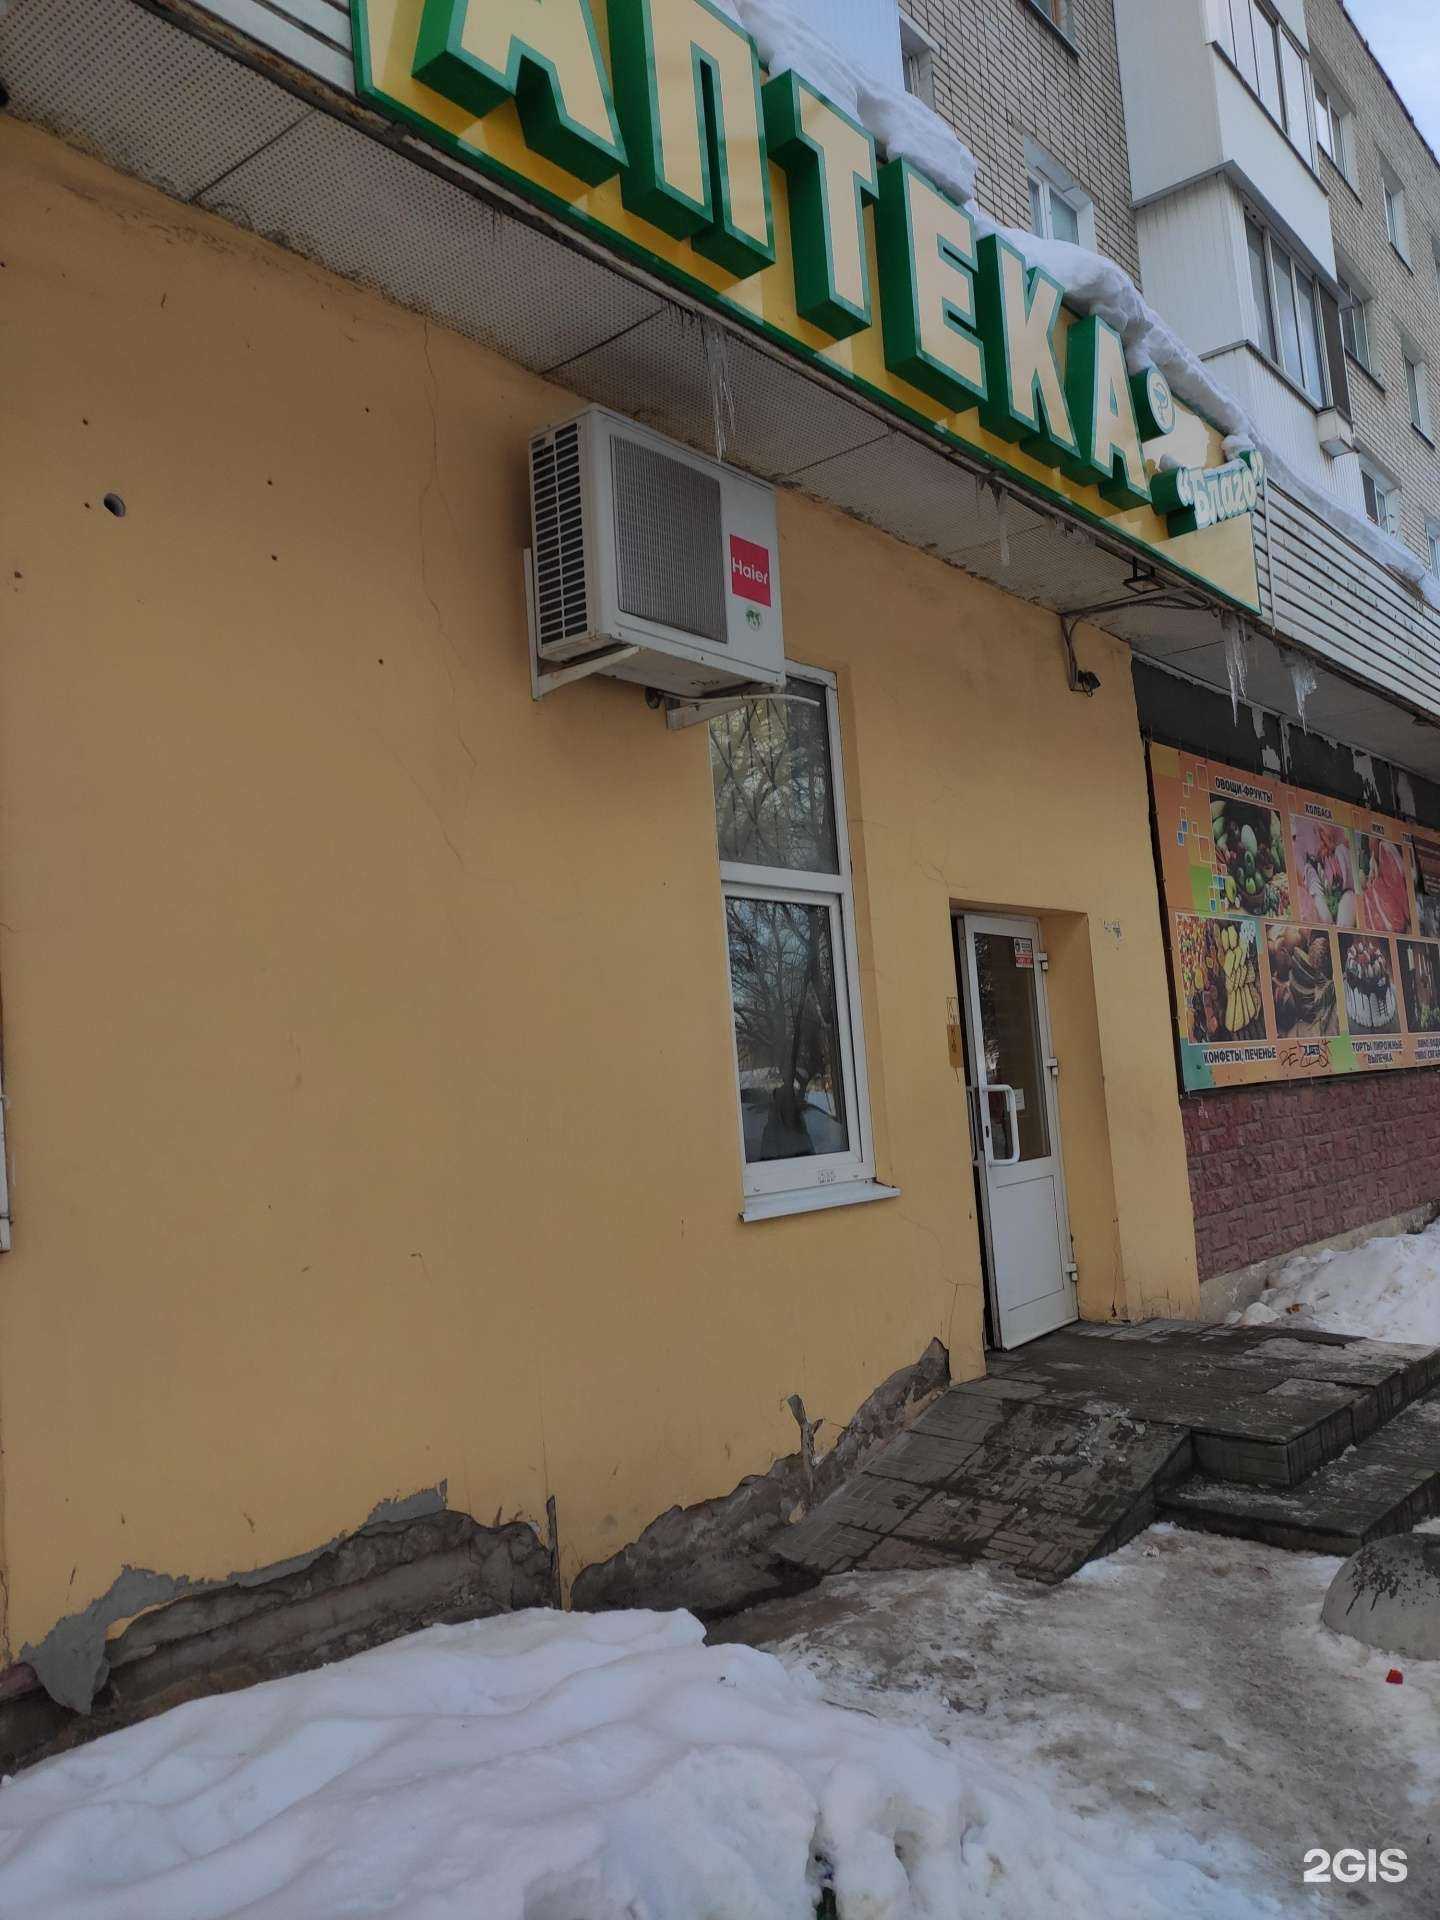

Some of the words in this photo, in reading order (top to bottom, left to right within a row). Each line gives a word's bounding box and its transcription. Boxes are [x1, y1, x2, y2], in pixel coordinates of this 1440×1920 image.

[428, 0, 1153, 507] АПТЕКА
[732, 557, 768, 585] Haier
[1215, 777, 1273, 804] ОВОЩИ-ФРУКТЫ
[1245, 1047, 1277, 1060] ПЕЧЕНЬЕ
